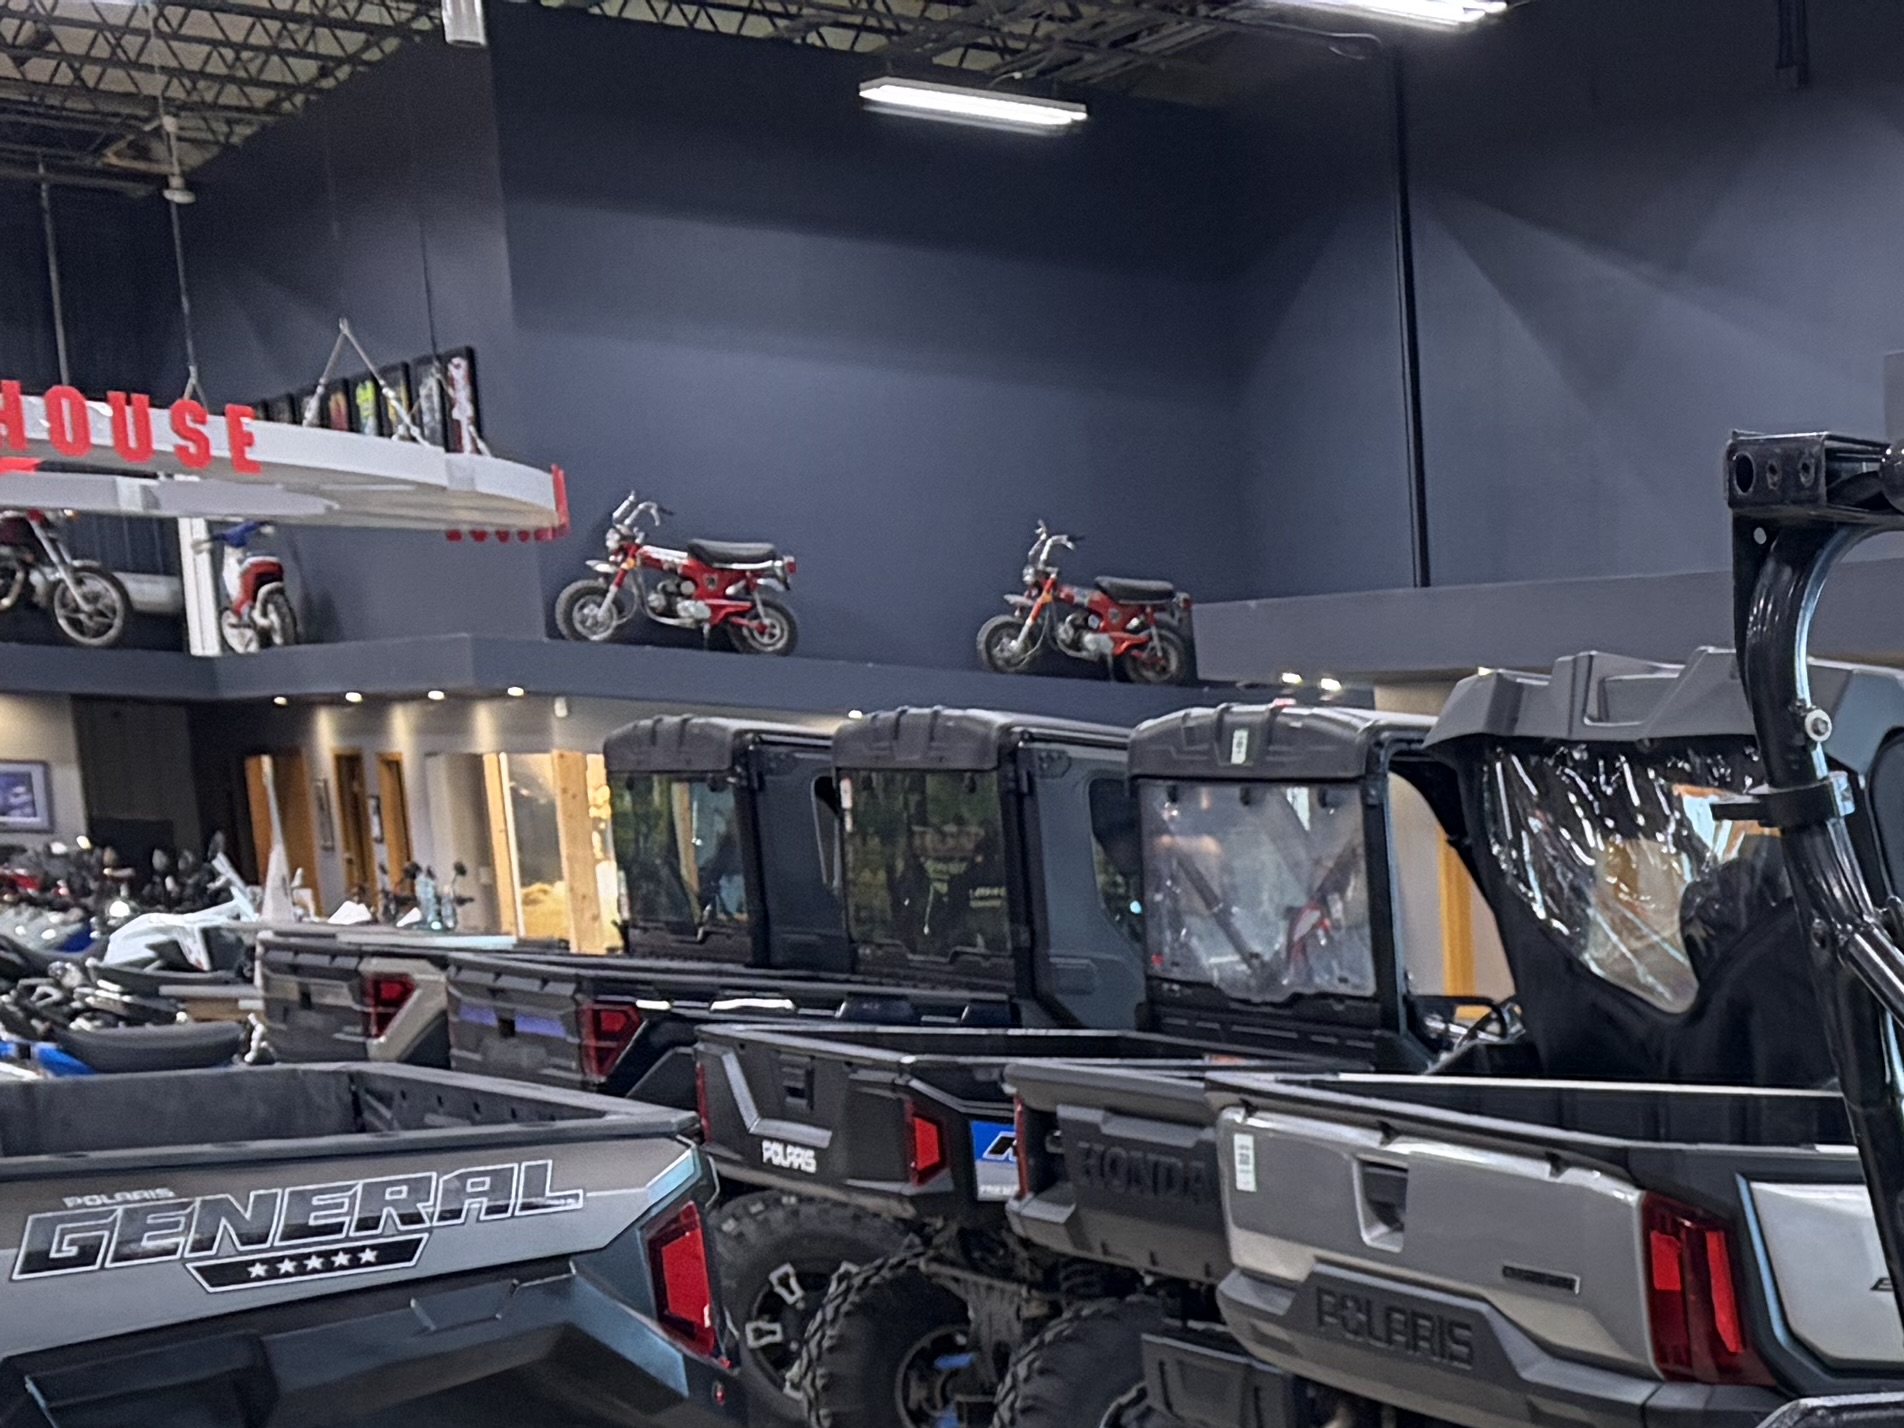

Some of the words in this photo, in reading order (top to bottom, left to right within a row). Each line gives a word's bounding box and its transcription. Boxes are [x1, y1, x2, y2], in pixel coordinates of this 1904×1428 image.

[762, 1139, 817, 1174] POLARIS
[1076, 1140, 1210, 1205] HONDA
[10, 1159, 585, 1280] GENERAL
[62, 1187, 177, 1208] POLARIS
[1317, 1286, 1474, 1371] POLARIS
